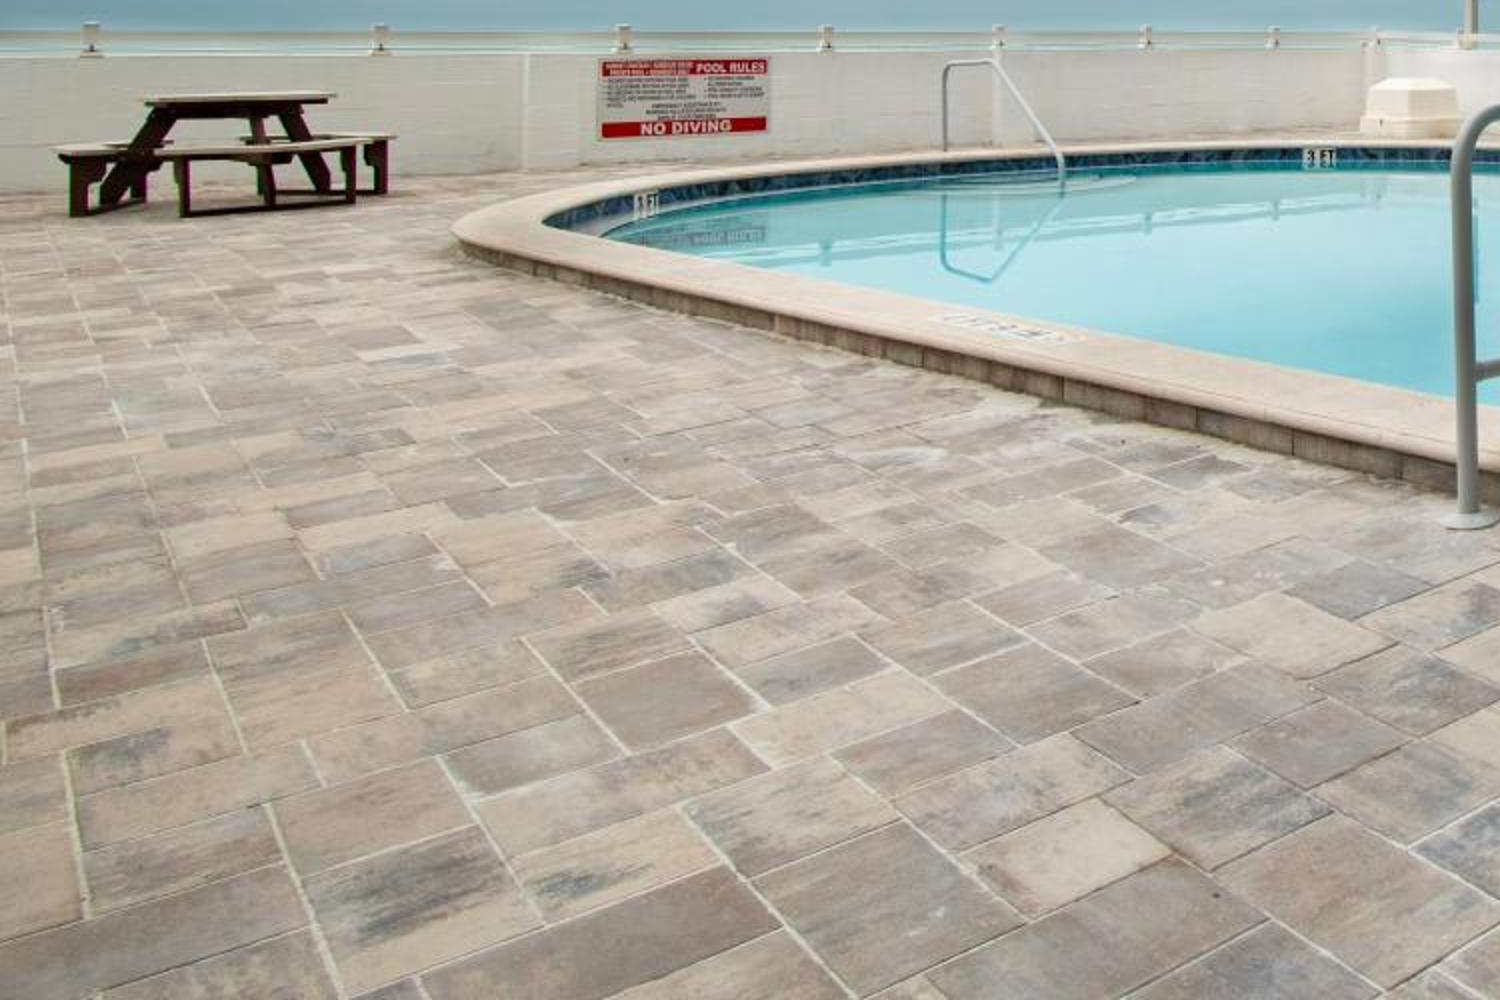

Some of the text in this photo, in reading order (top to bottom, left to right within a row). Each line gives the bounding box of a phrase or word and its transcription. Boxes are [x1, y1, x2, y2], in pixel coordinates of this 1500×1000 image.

[696, 63, 727, 73] POOL
[730, 61, 765, 73] RULES
[640, 119, 733, 136] NO DIVING
